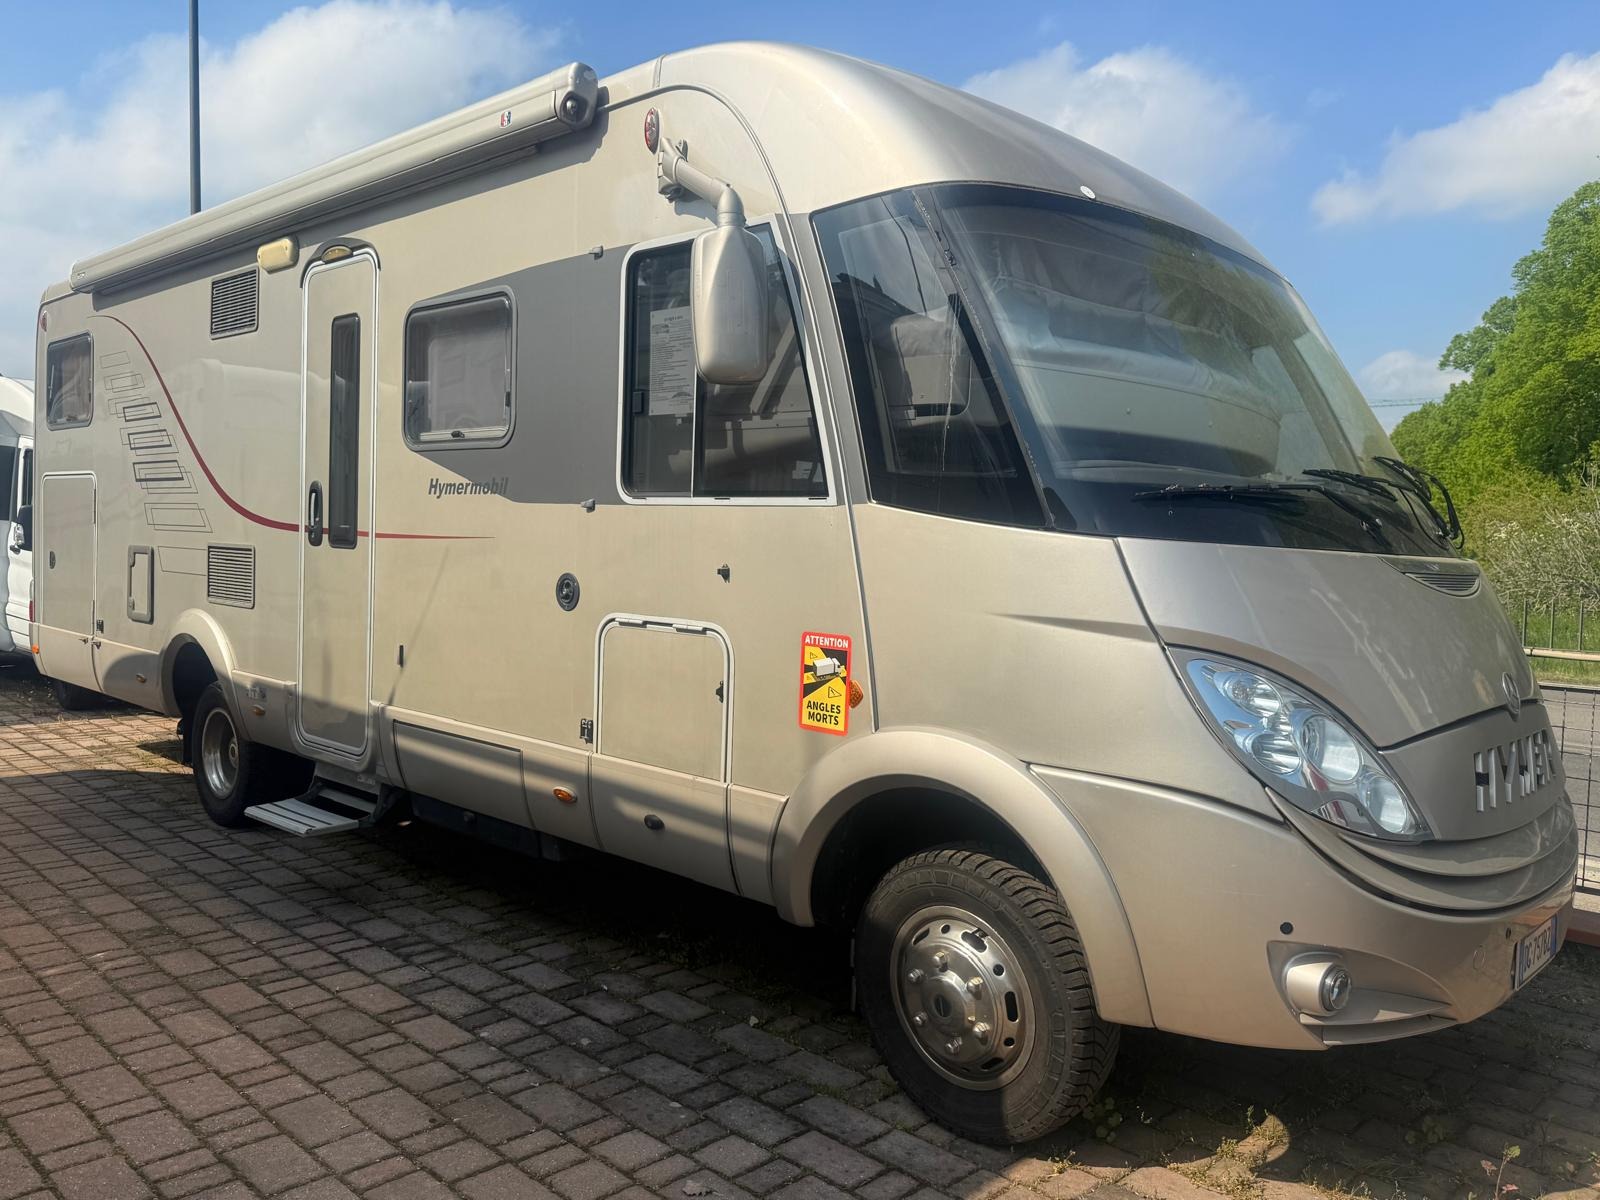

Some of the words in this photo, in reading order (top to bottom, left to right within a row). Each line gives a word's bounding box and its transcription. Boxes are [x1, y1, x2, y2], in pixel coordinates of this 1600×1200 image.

[428, 477, 509, 499] Hymermobil
[804, 635, 849, 648] ATTENTION
[806, 700, 841, 714] ANGLES
[807, 711, 839, 726] MORTS
[1473, 728, 1556, 812] HYMER
